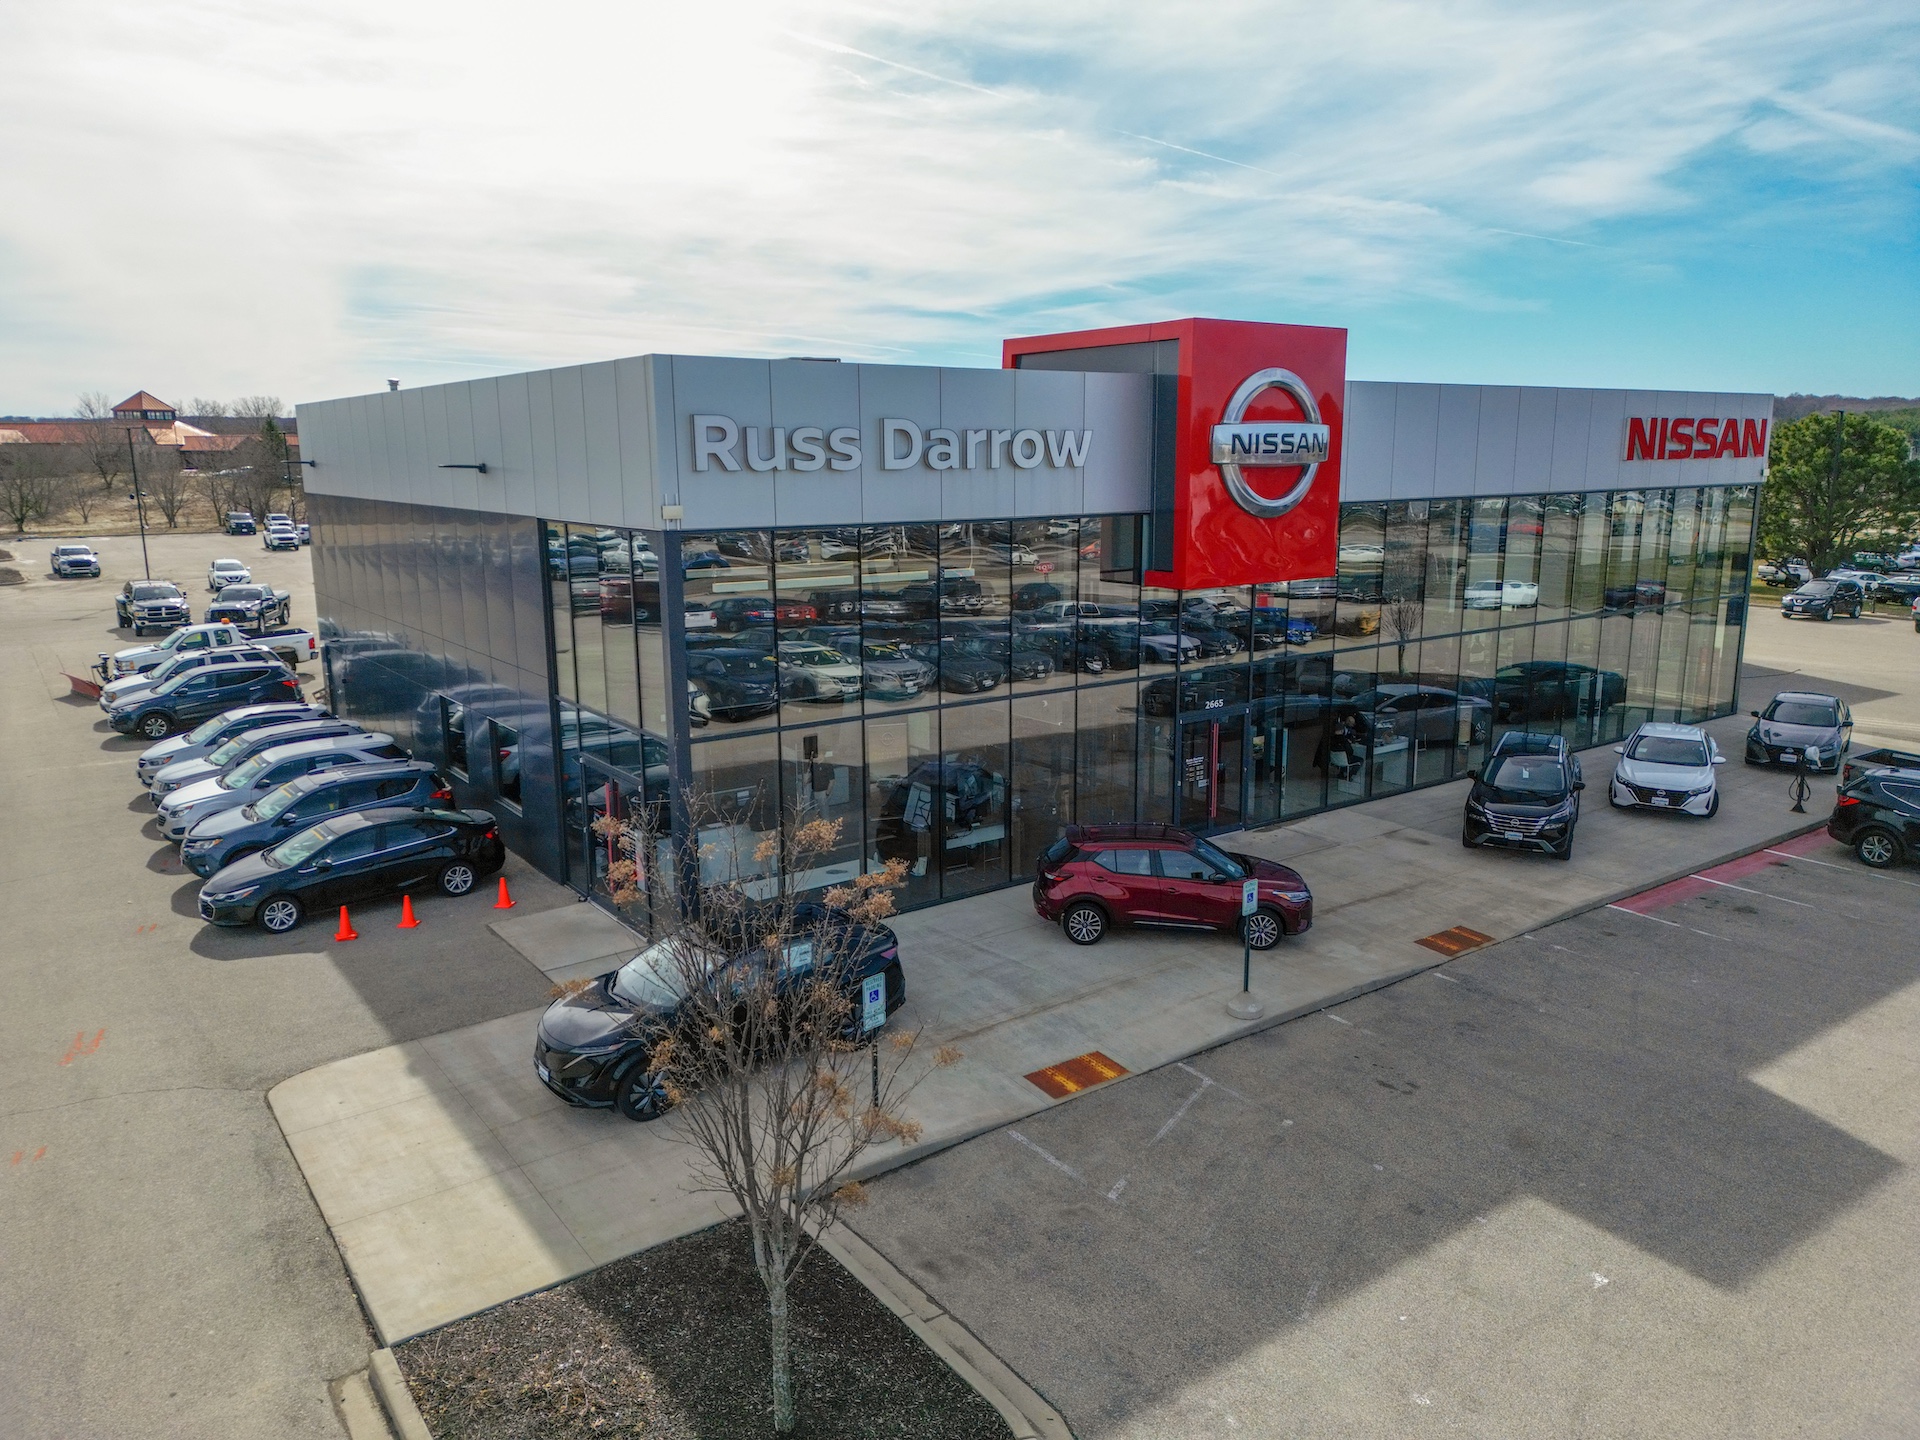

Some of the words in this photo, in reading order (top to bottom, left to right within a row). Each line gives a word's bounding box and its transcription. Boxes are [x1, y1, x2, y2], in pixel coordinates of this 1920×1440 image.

[690, 414, 863, 471] Russ
[879, 417, 1093, 470] Darrow
[1231, 432, 1324, 454] NISSAN
[1624, 417, 1767, 460] NISSAN
[1205, 699, 1224, 709] 2665
